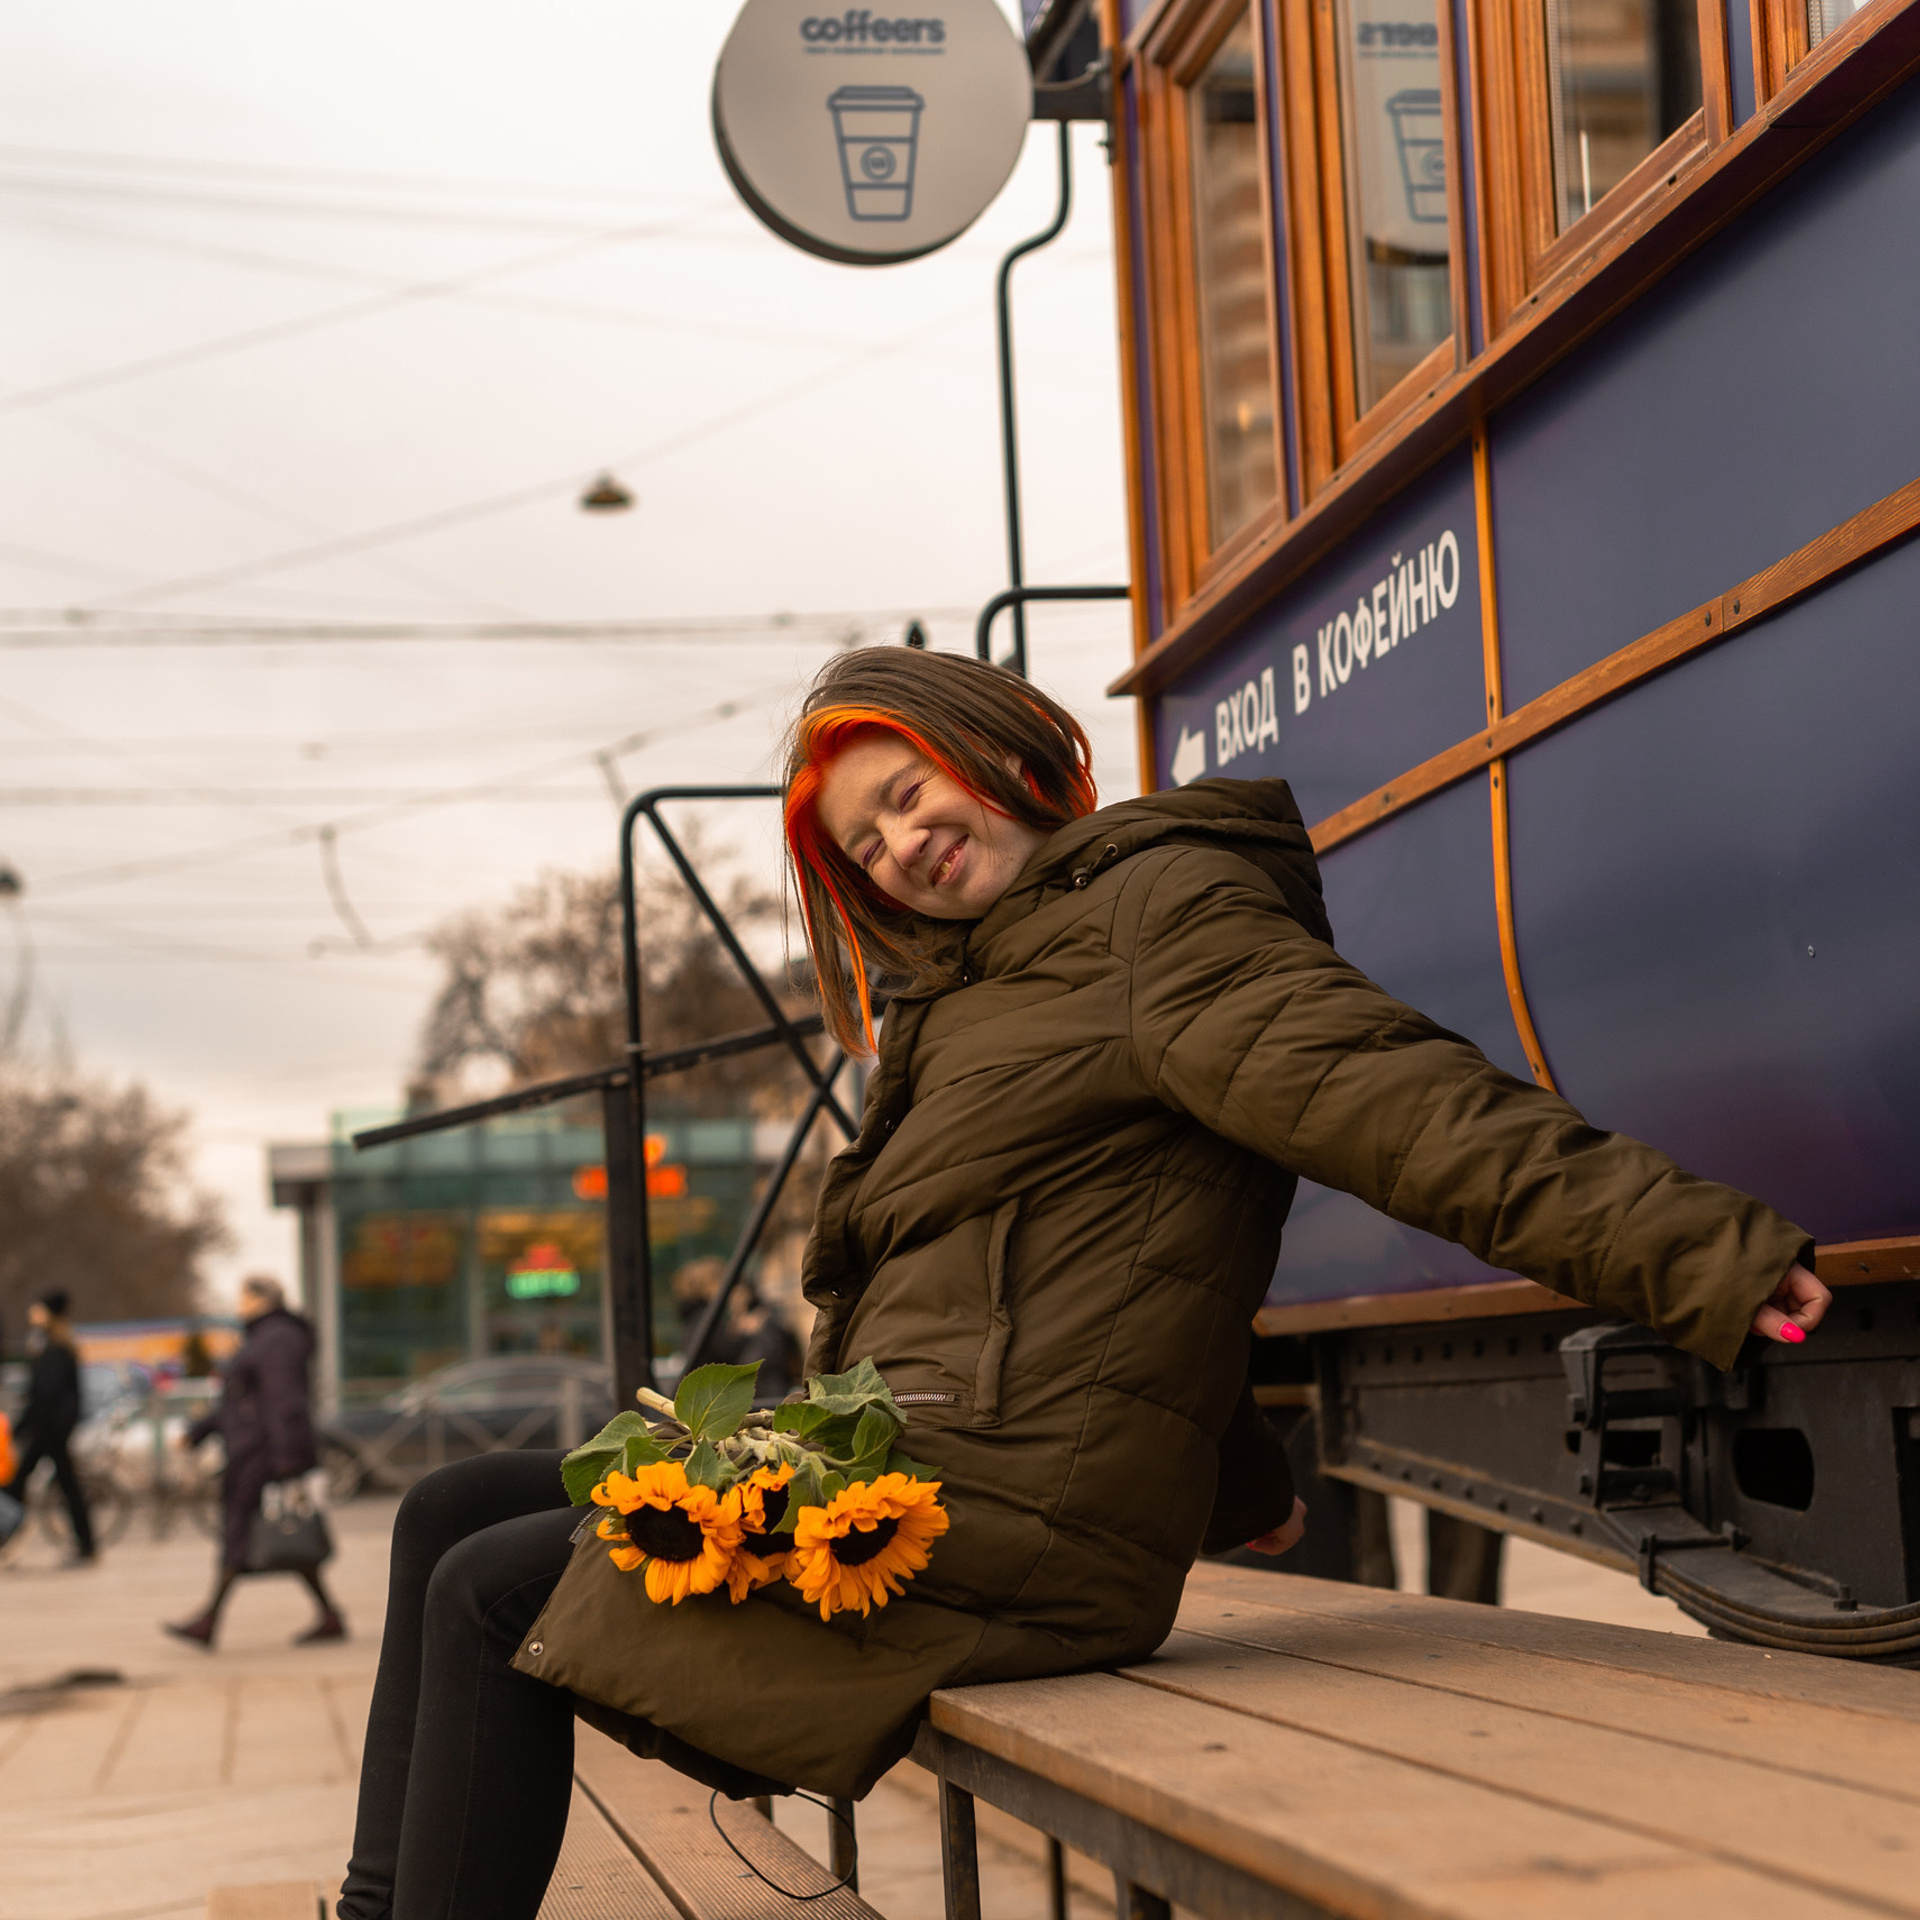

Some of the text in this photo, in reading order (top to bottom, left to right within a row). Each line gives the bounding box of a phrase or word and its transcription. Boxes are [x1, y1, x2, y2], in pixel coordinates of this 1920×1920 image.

[800, 9, 946, 42] coffeers
[1215, 529, 1460, 767] ВХОД В КОФЕЙНЮ
